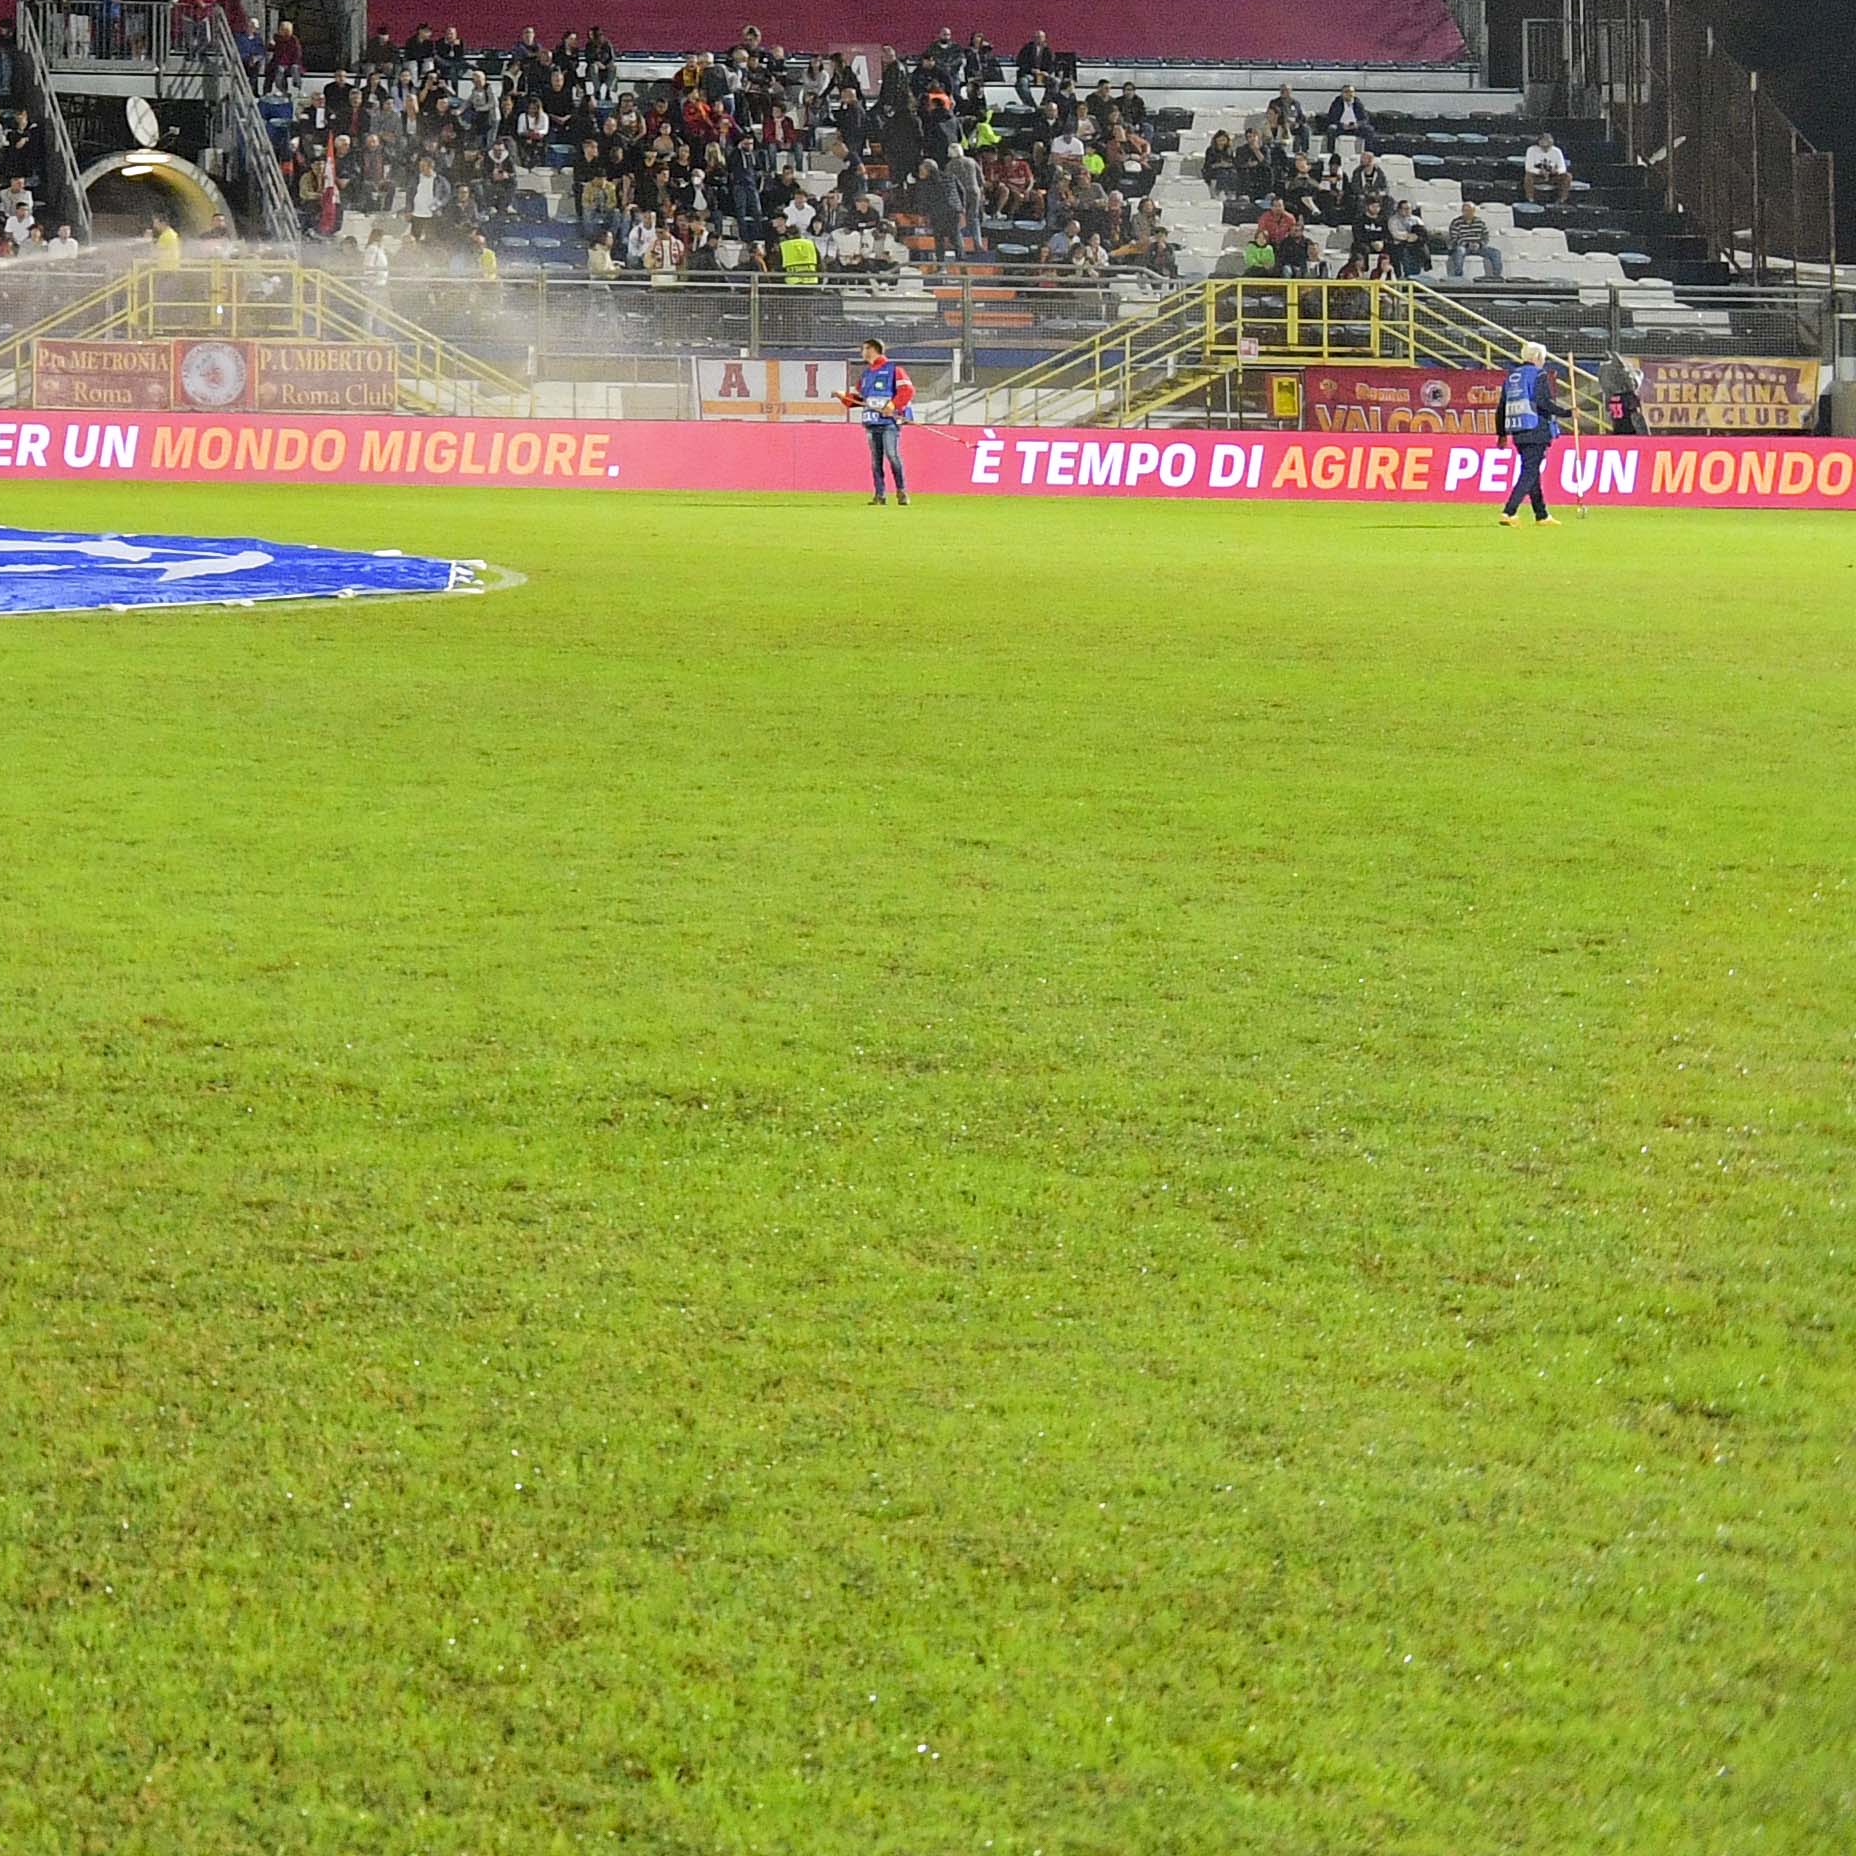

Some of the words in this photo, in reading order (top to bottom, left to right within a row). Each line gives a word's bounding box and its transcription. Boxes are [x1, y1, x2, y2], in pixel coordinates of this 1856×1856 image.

[69, 349, 171, 371] METRONIA
[280, 348, 384, 372] UMBERTO
[73, 381, 133, 403] Roma
[718, 363, 750, 398] A
[280, 383, 340, 405] Roma
[344, 382, 395, 406] Club
[1653, 382, 1789, 404] TERRACINA
[1648, 406, 1710, 427] OMA
[1722, 406, 1790, 427] CLUB
[63, 424, 140, 469] UN
[150, 426, 347, 472] MONDO
[358, 429, 621, 478] MIGLIORE.
[971, 428, 1006, 484] È
[1015, 440, 1197, 488] TEMPO
[1208, 444, 1264, 489] DI
[1271, 446, 1433, 491] AGIRE
[1560, 449, 1639, 495] UN
[1651, 450, 1854, 496] MONDO
